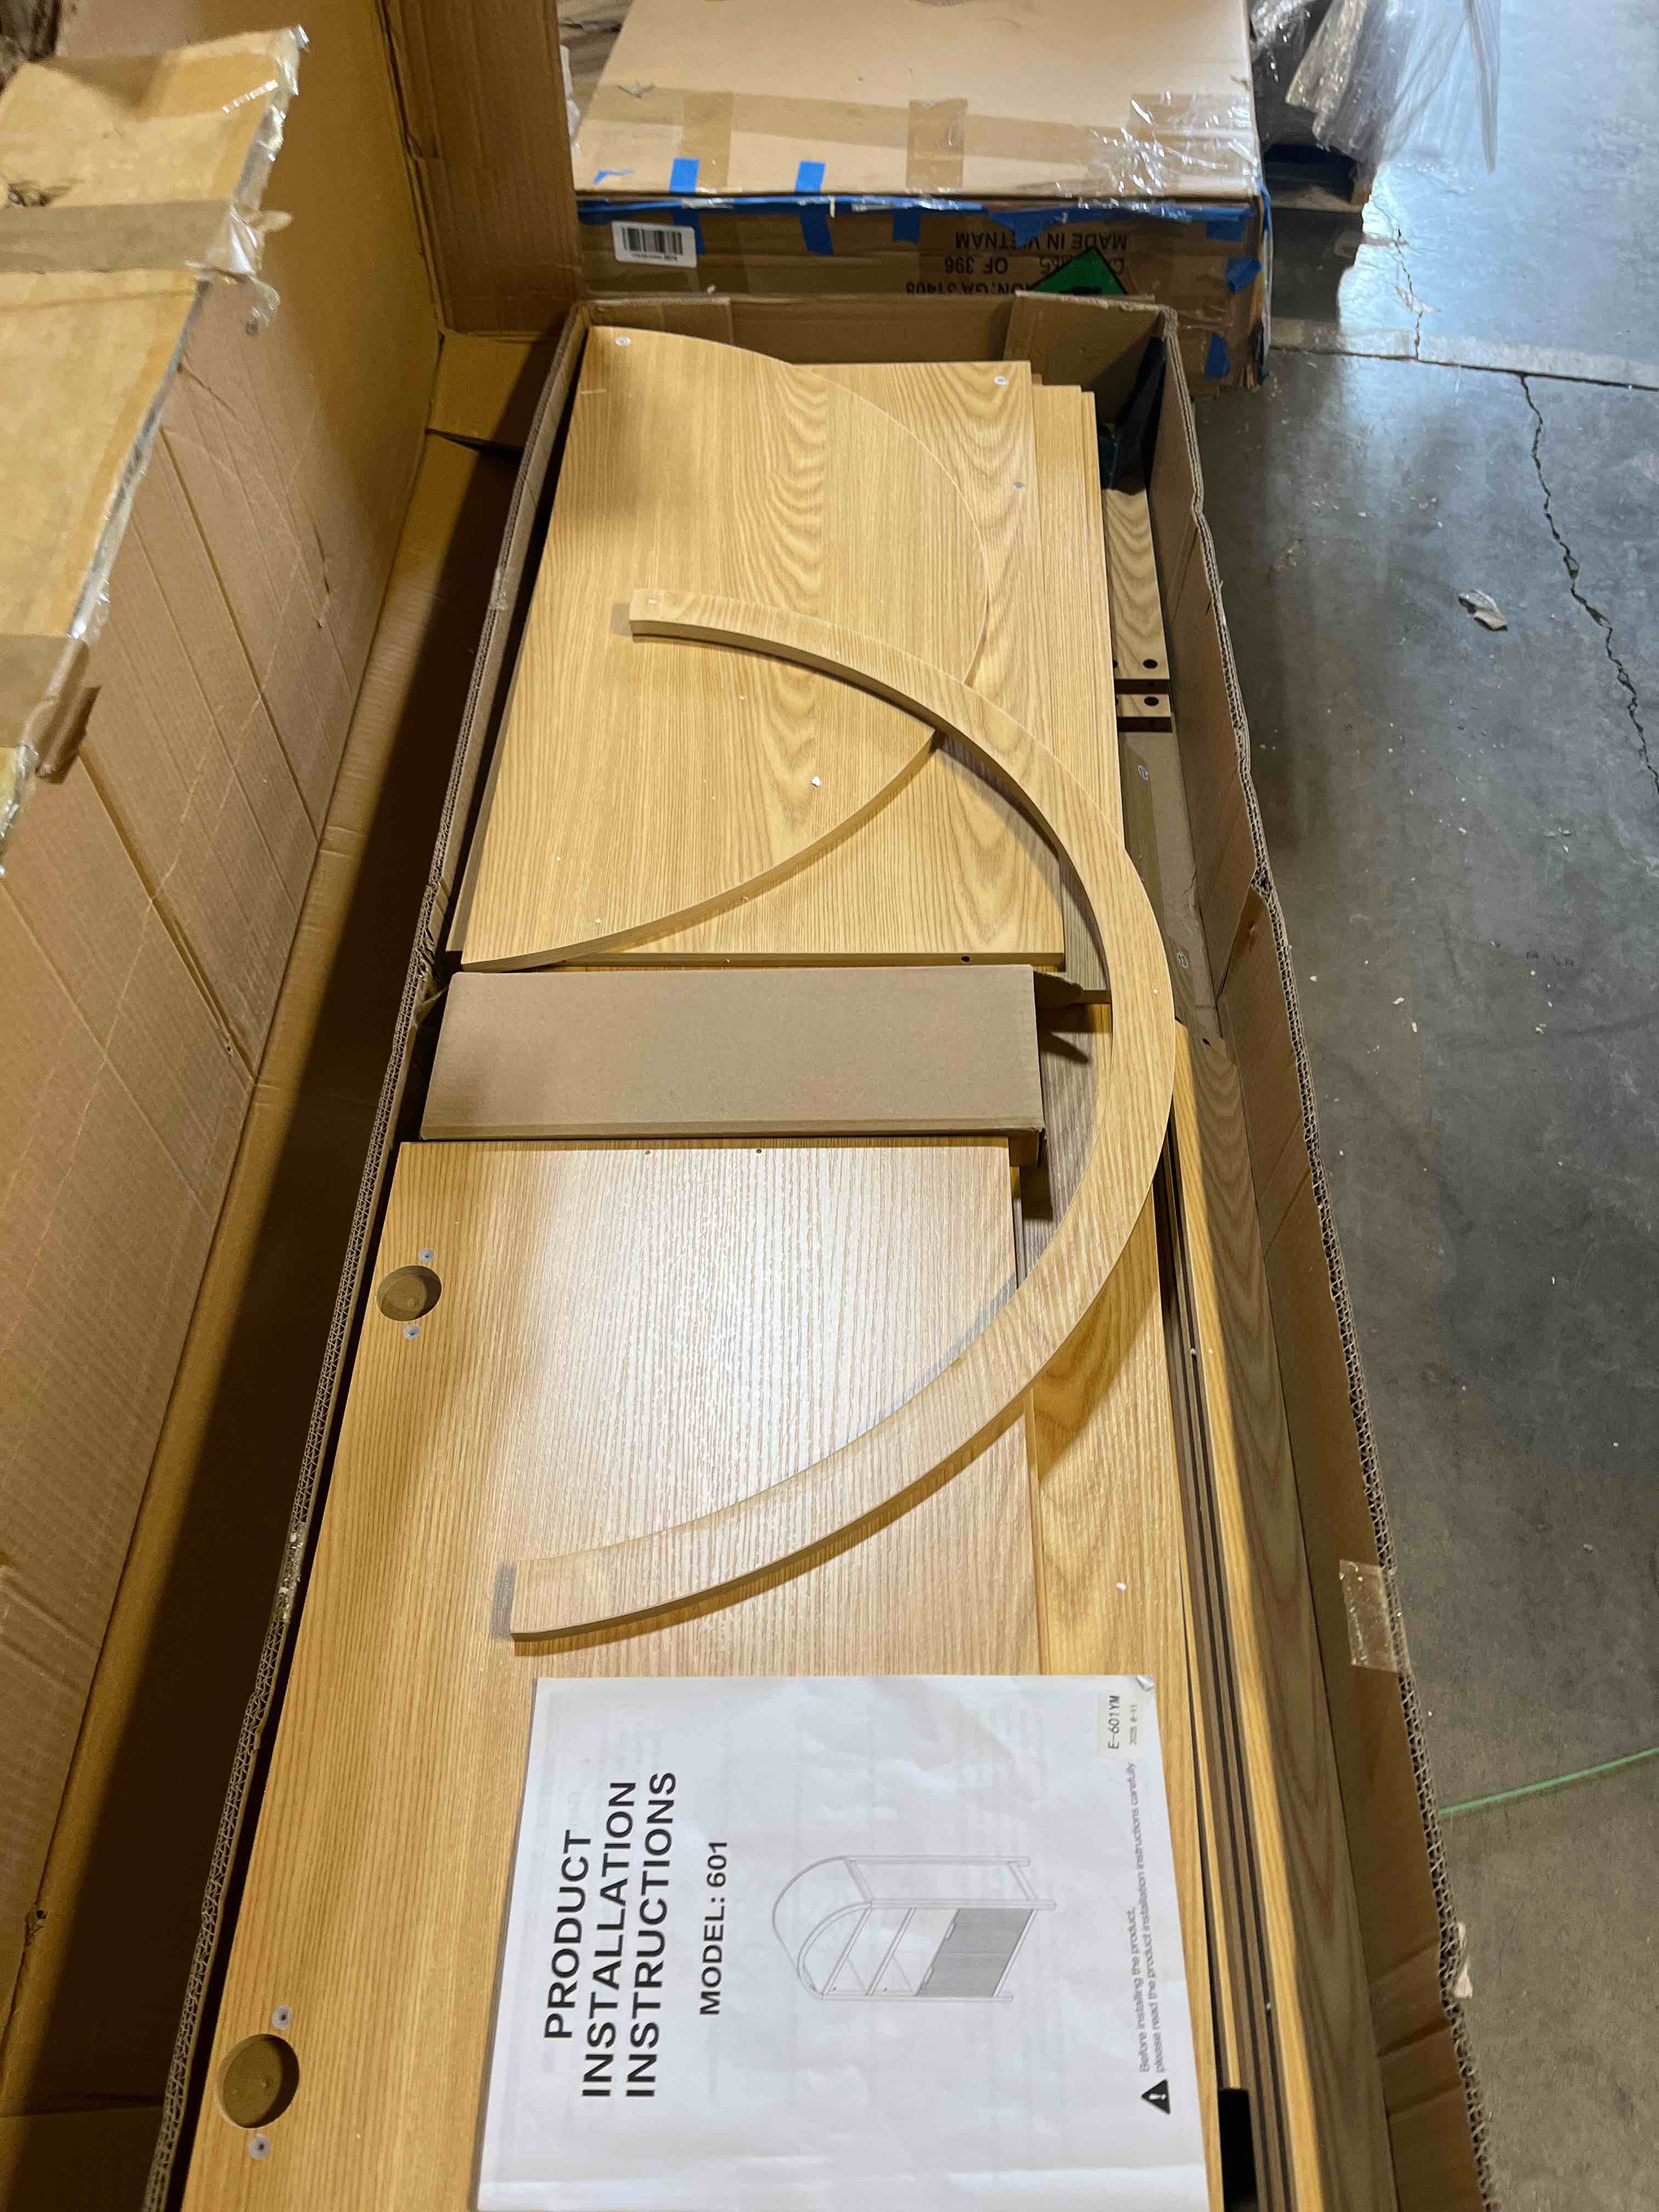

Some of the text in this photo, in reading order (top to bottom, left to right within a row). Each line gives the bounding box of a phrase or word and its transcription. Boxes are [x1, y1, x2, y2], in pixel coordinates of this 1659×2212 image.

[944, 257, 975, 274] 396
[956, 232, 1127, 250] MADE IN VETNAM
[983, 258, 1008, 274] OF
[1107, 1694, 1121, 1750] E-601YM
[543, 1829, 592, 2039] PRODUCT
[581, 1782, 637, 2098] INSTALLATION
[625, 1772, 677, 2098] INSTRUCTIONS
[699, 1842, 728, 2016] MODEL: 601
[1125, 1762, 1166, 2073] please read the product installation instructions carefully
[1130, 1956, 1140, 1976] the
[1132, 1978, 1146, 2029] installing
[1137, 2032, 1150, 2073] Before
